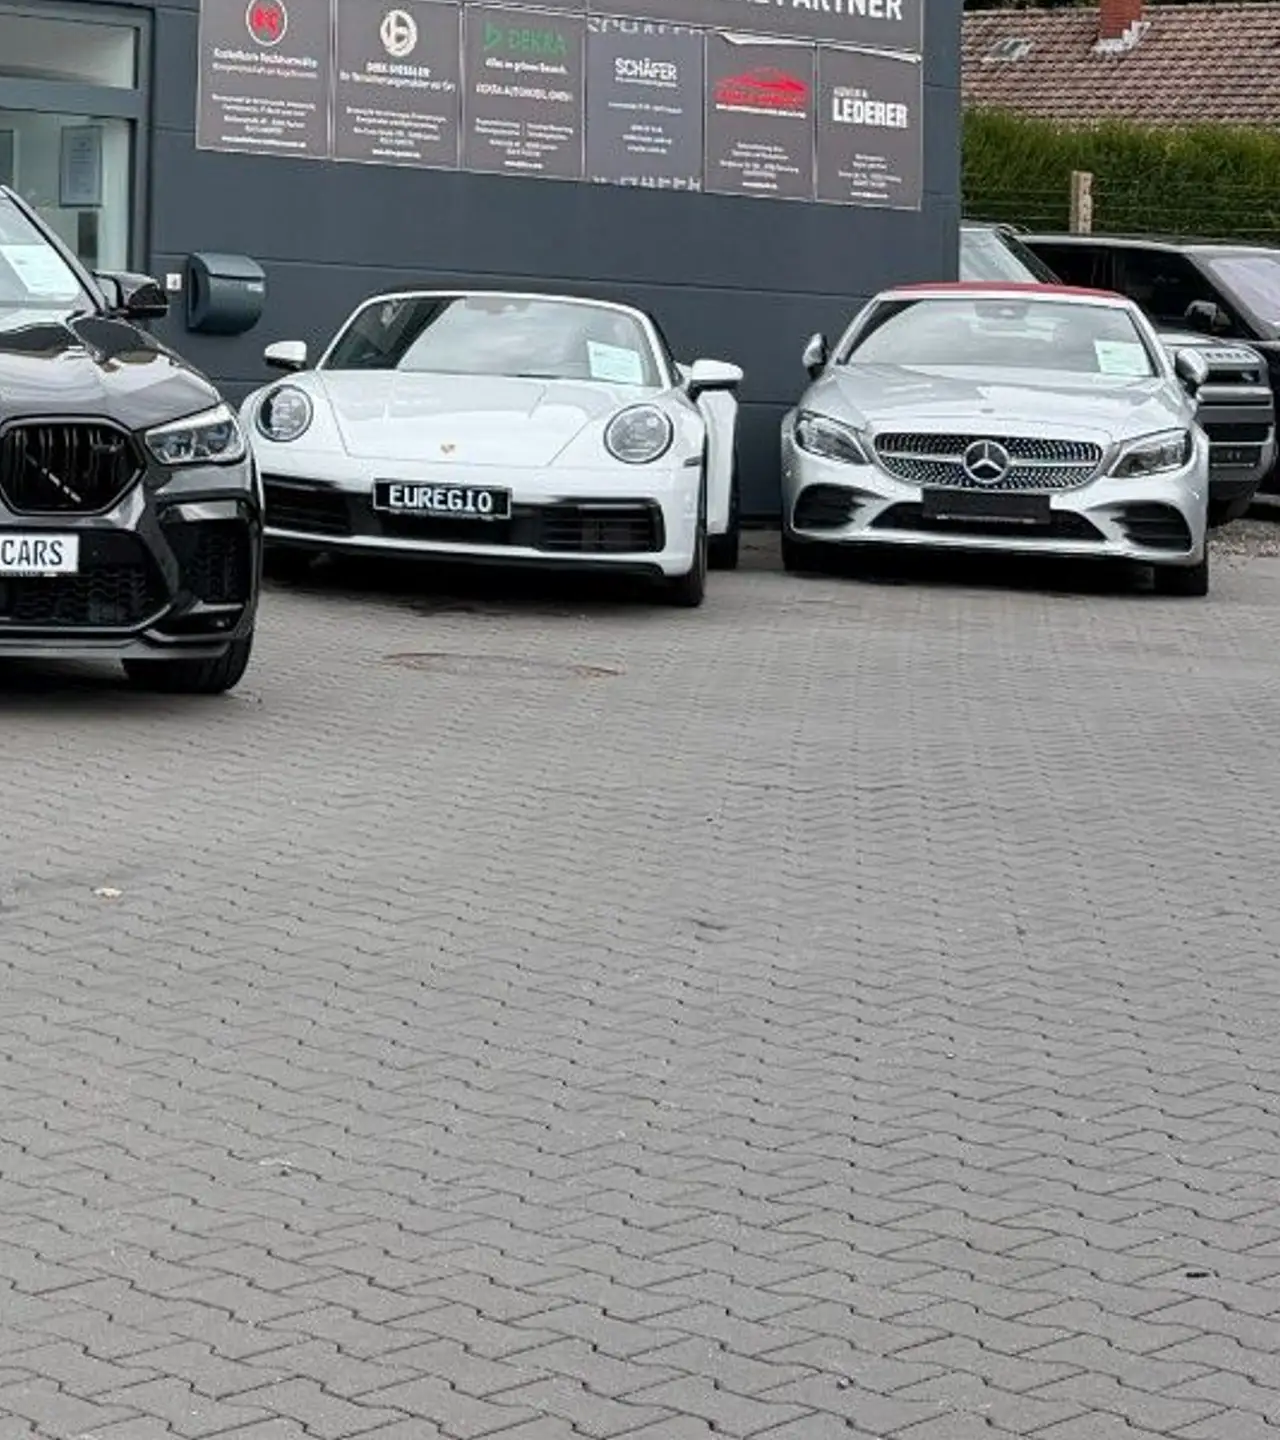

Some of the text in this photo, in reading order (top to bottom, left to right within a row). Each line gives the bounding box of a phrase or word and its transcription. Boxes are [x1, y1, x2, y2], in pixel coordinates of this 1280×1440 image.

[614, 57, 678, 81] SCHÄFER
[832, 97, 909, 129] LEDERER
[389, 484, 493, 513] EUREGIO
